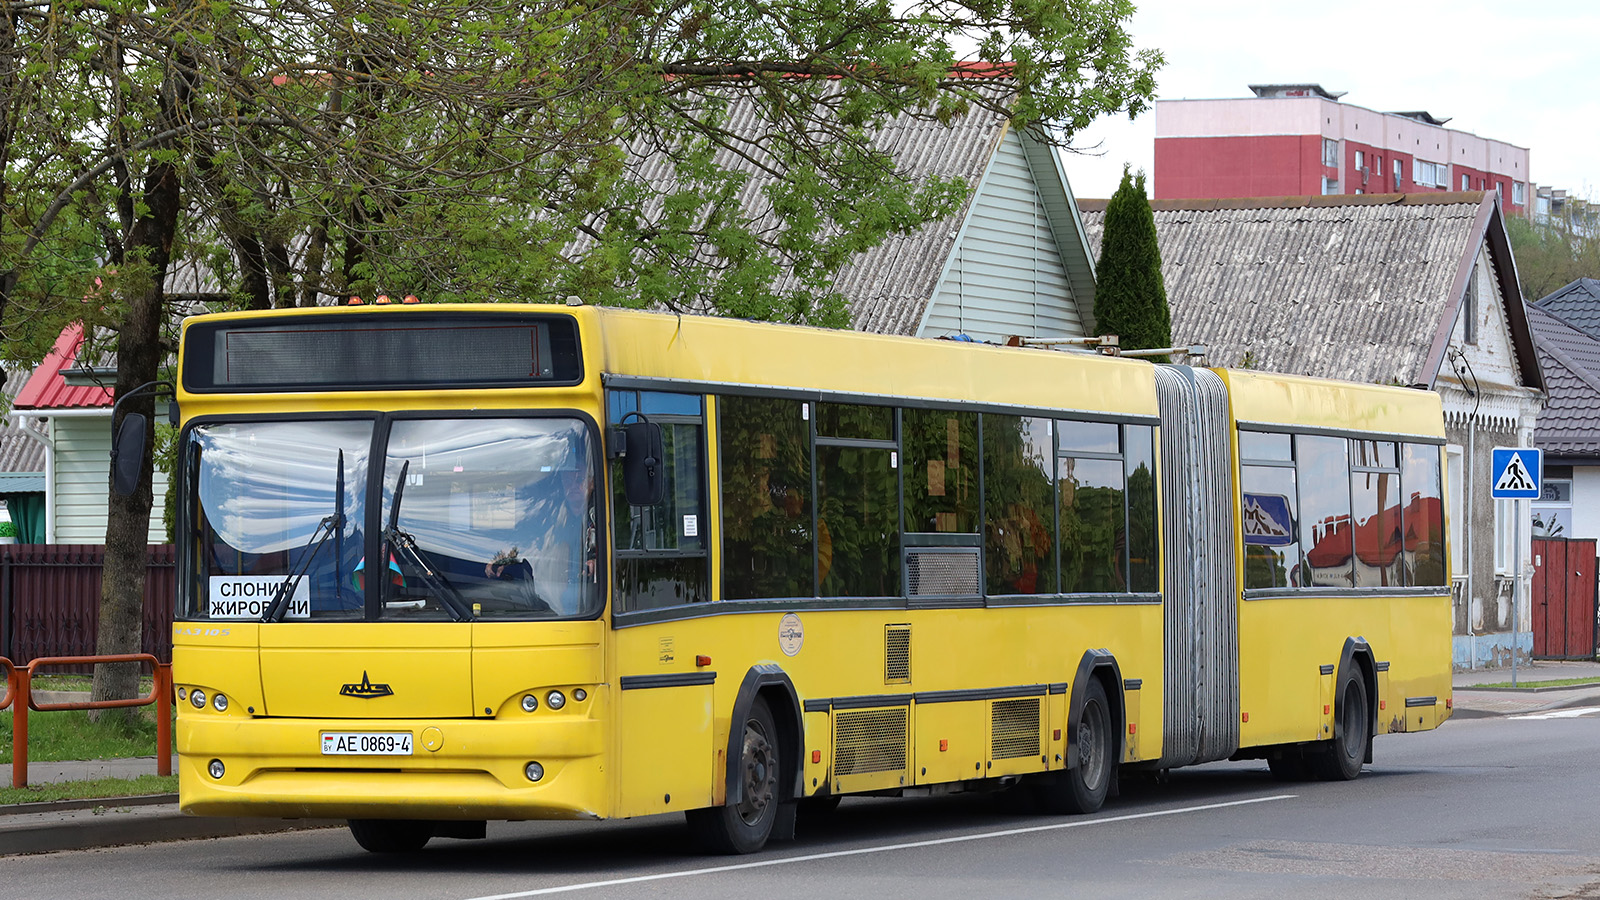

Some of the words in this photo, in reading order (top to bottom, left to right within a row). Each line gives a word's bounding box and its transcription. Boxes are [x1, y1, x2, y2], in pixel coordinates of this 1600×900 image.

[211, 600, 308, 615] ЖИРОЧИ
[204, 628, 231, 636] 105
[336, 736, 357, 752] AE
[361, 736, 410, 752] 0869-4
